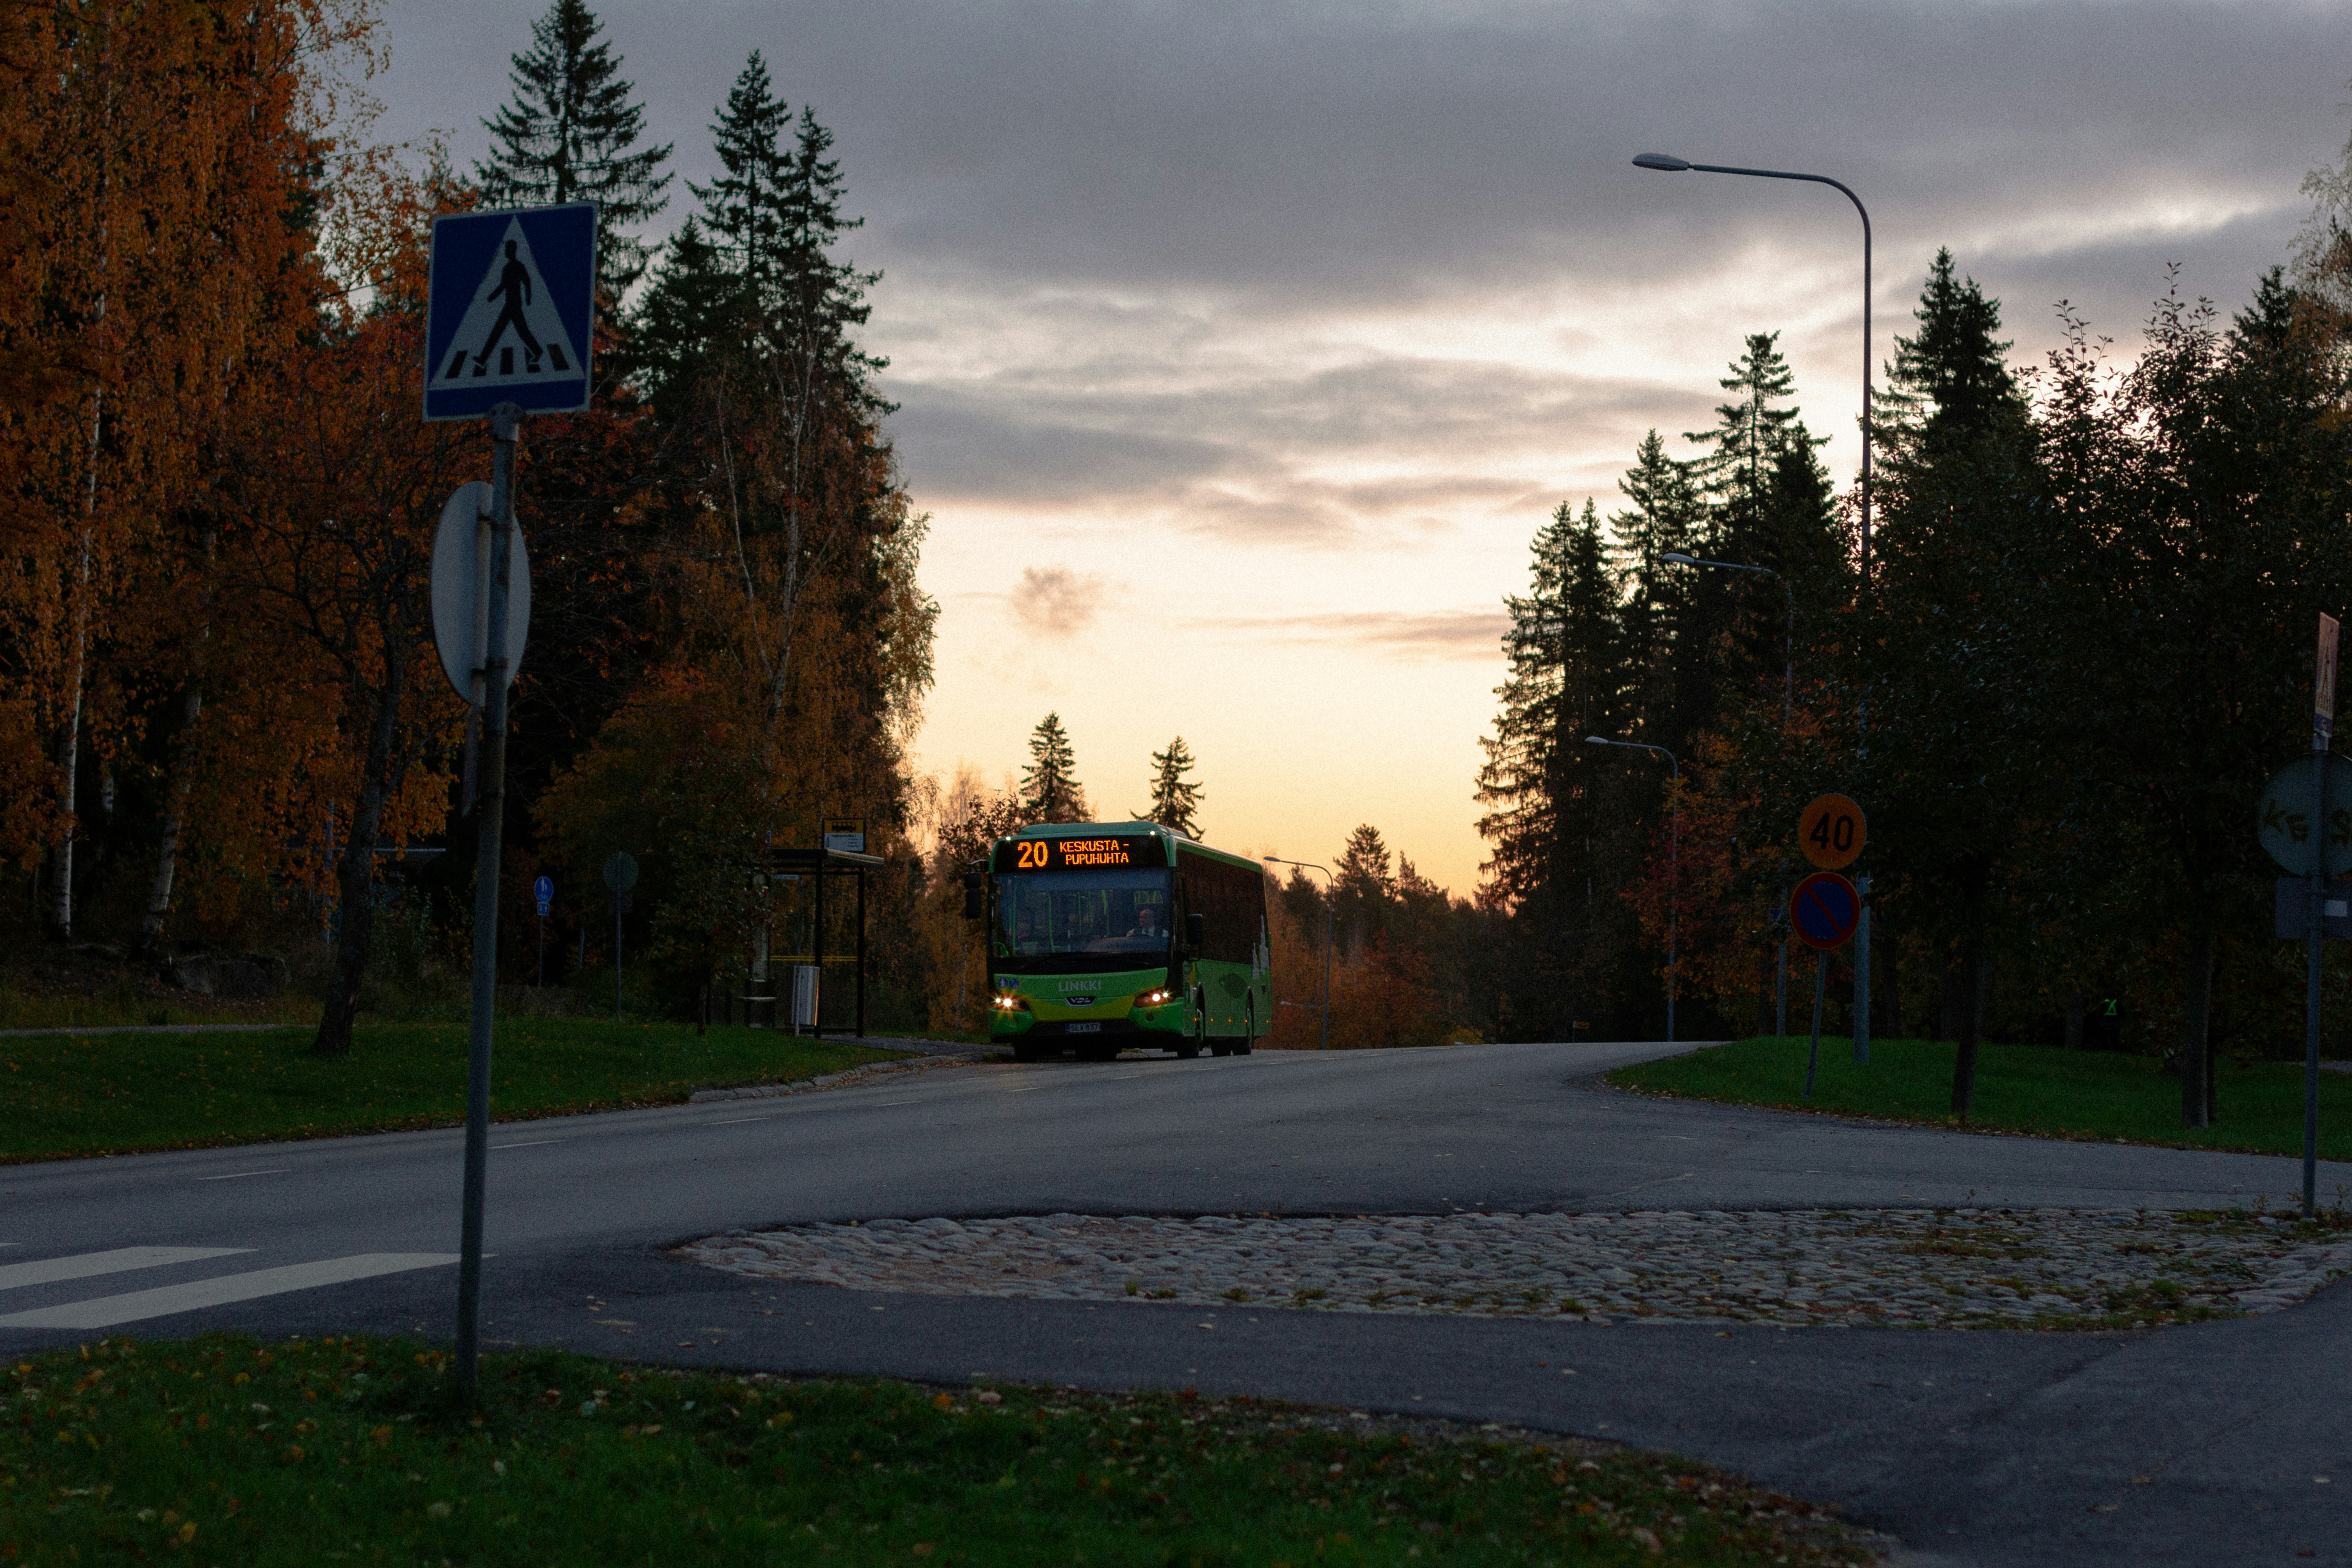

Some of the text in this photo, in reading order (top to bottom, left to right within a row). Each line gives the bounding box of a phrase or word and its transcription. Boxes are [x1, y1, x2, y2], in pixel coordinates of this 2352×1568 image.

[1810, 813, 1854, 851] 40
[1059, 840, 1119, 852] KESKUSTA
[1017, 841, 1048, 867] 20
[1065, 852, 1129, 865] PUPUHUHTA
[1058, 980, 1101, 992] LINKKI
